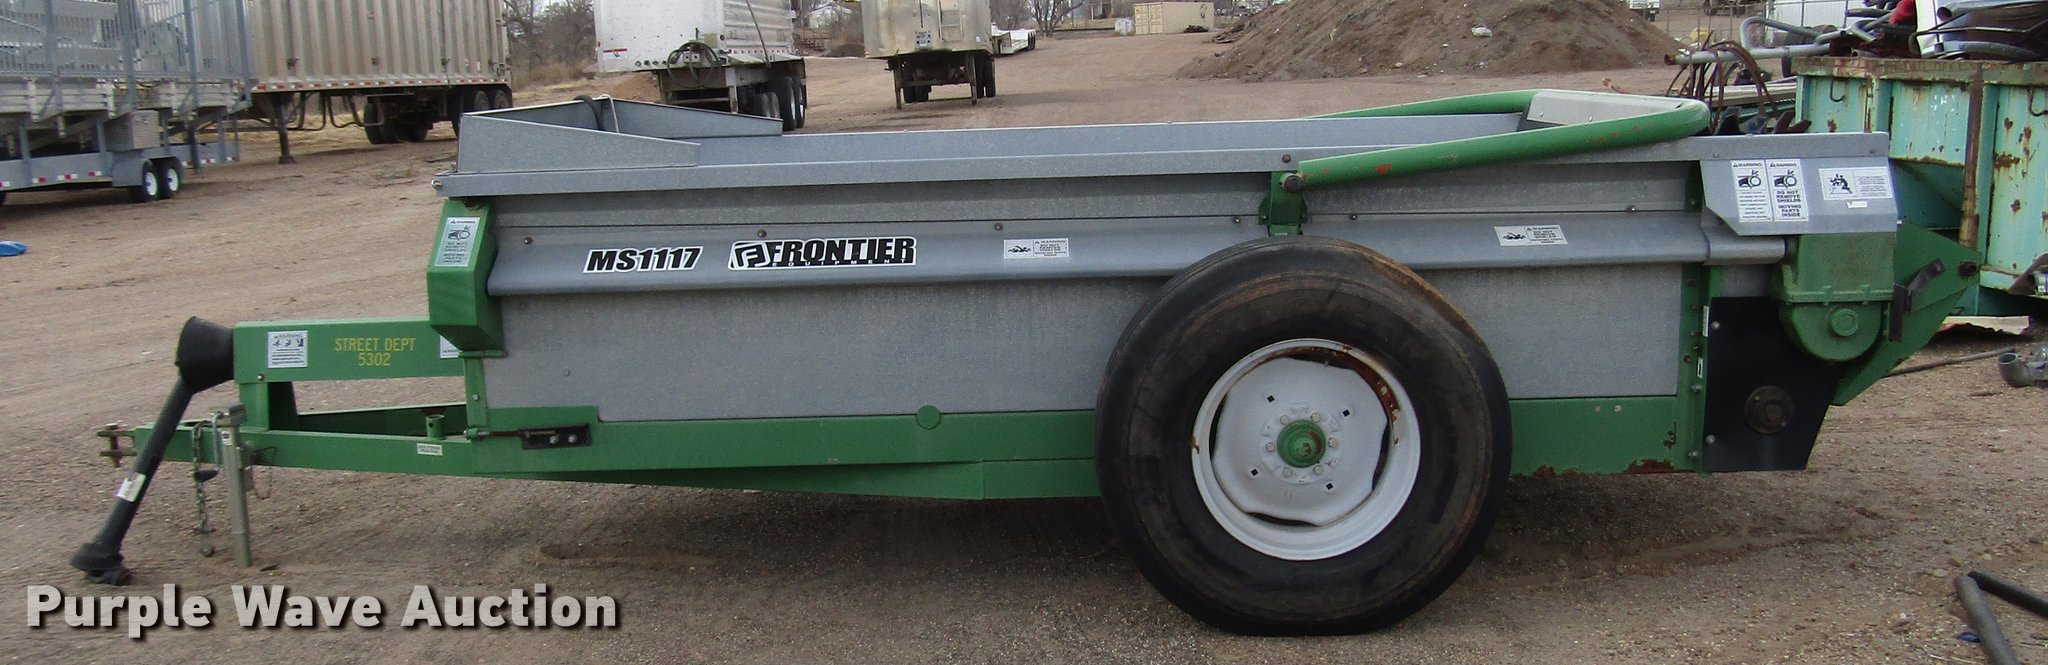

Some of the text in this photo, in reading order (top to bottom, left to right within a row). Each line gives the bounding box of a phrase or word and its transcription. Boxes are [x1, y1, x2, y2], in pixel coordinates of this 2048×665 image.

[768, 238, 916, 265] FRONTIER
[585, 247, 702, 272] MS1117
[771, 258, 907, 267] EQUIPMENT
[335, 337, 416, 352] STREET DEPT
[358, 352, 392, 366] 5302
